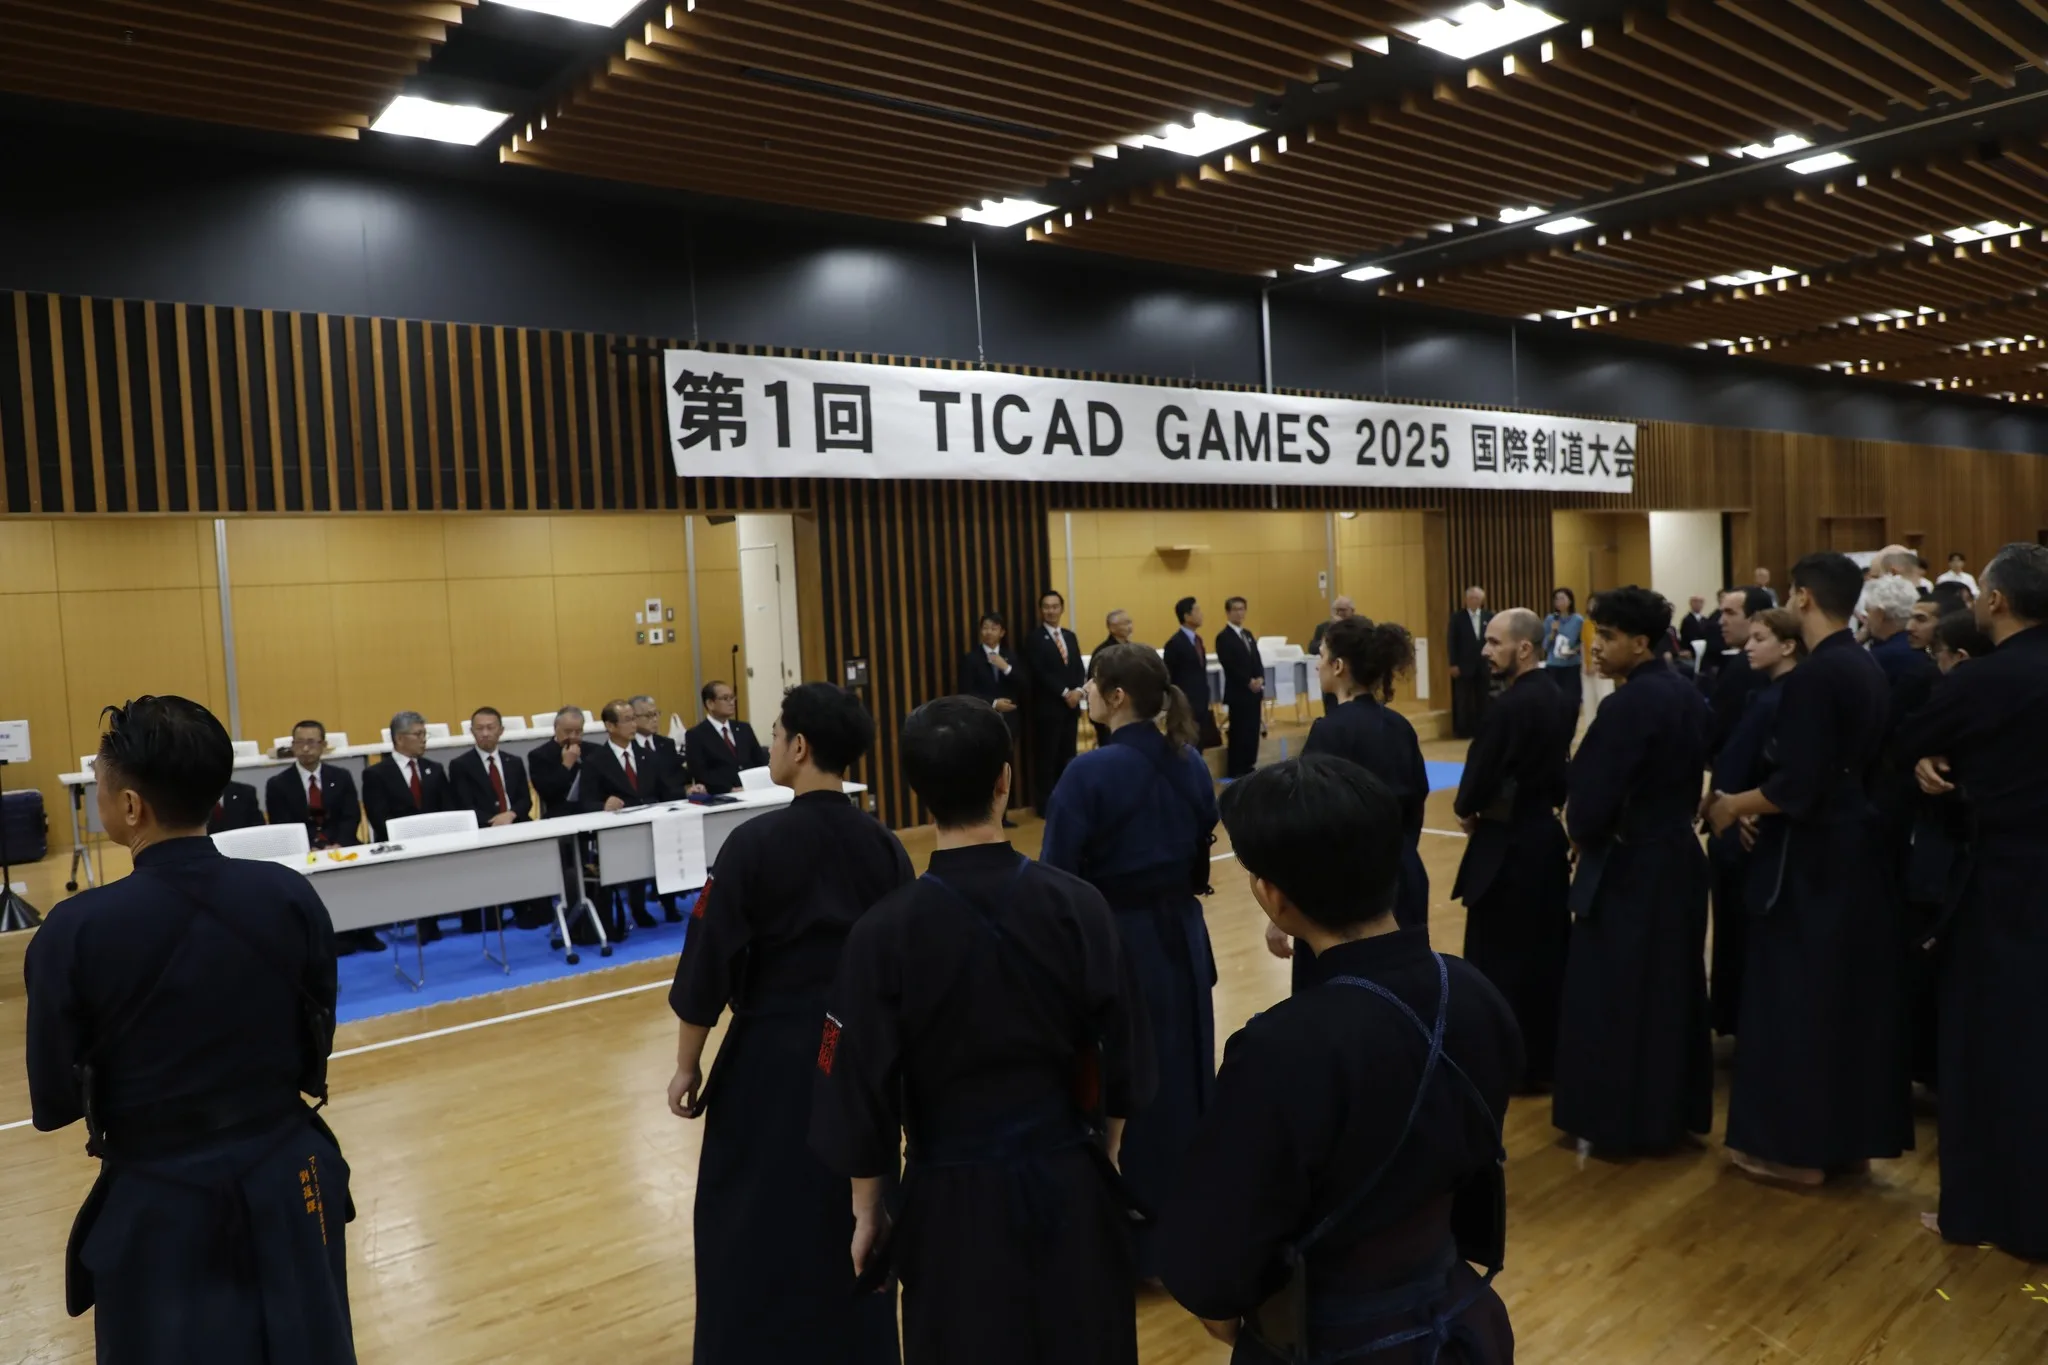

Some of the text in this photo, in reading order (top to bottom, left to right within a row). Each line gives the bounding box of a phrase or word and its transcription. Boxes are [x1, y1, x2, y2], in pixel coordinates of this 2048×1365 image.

[673, 369, 1635, 478] 第1回 TICAD GAMES 2025 国際剣道大会
